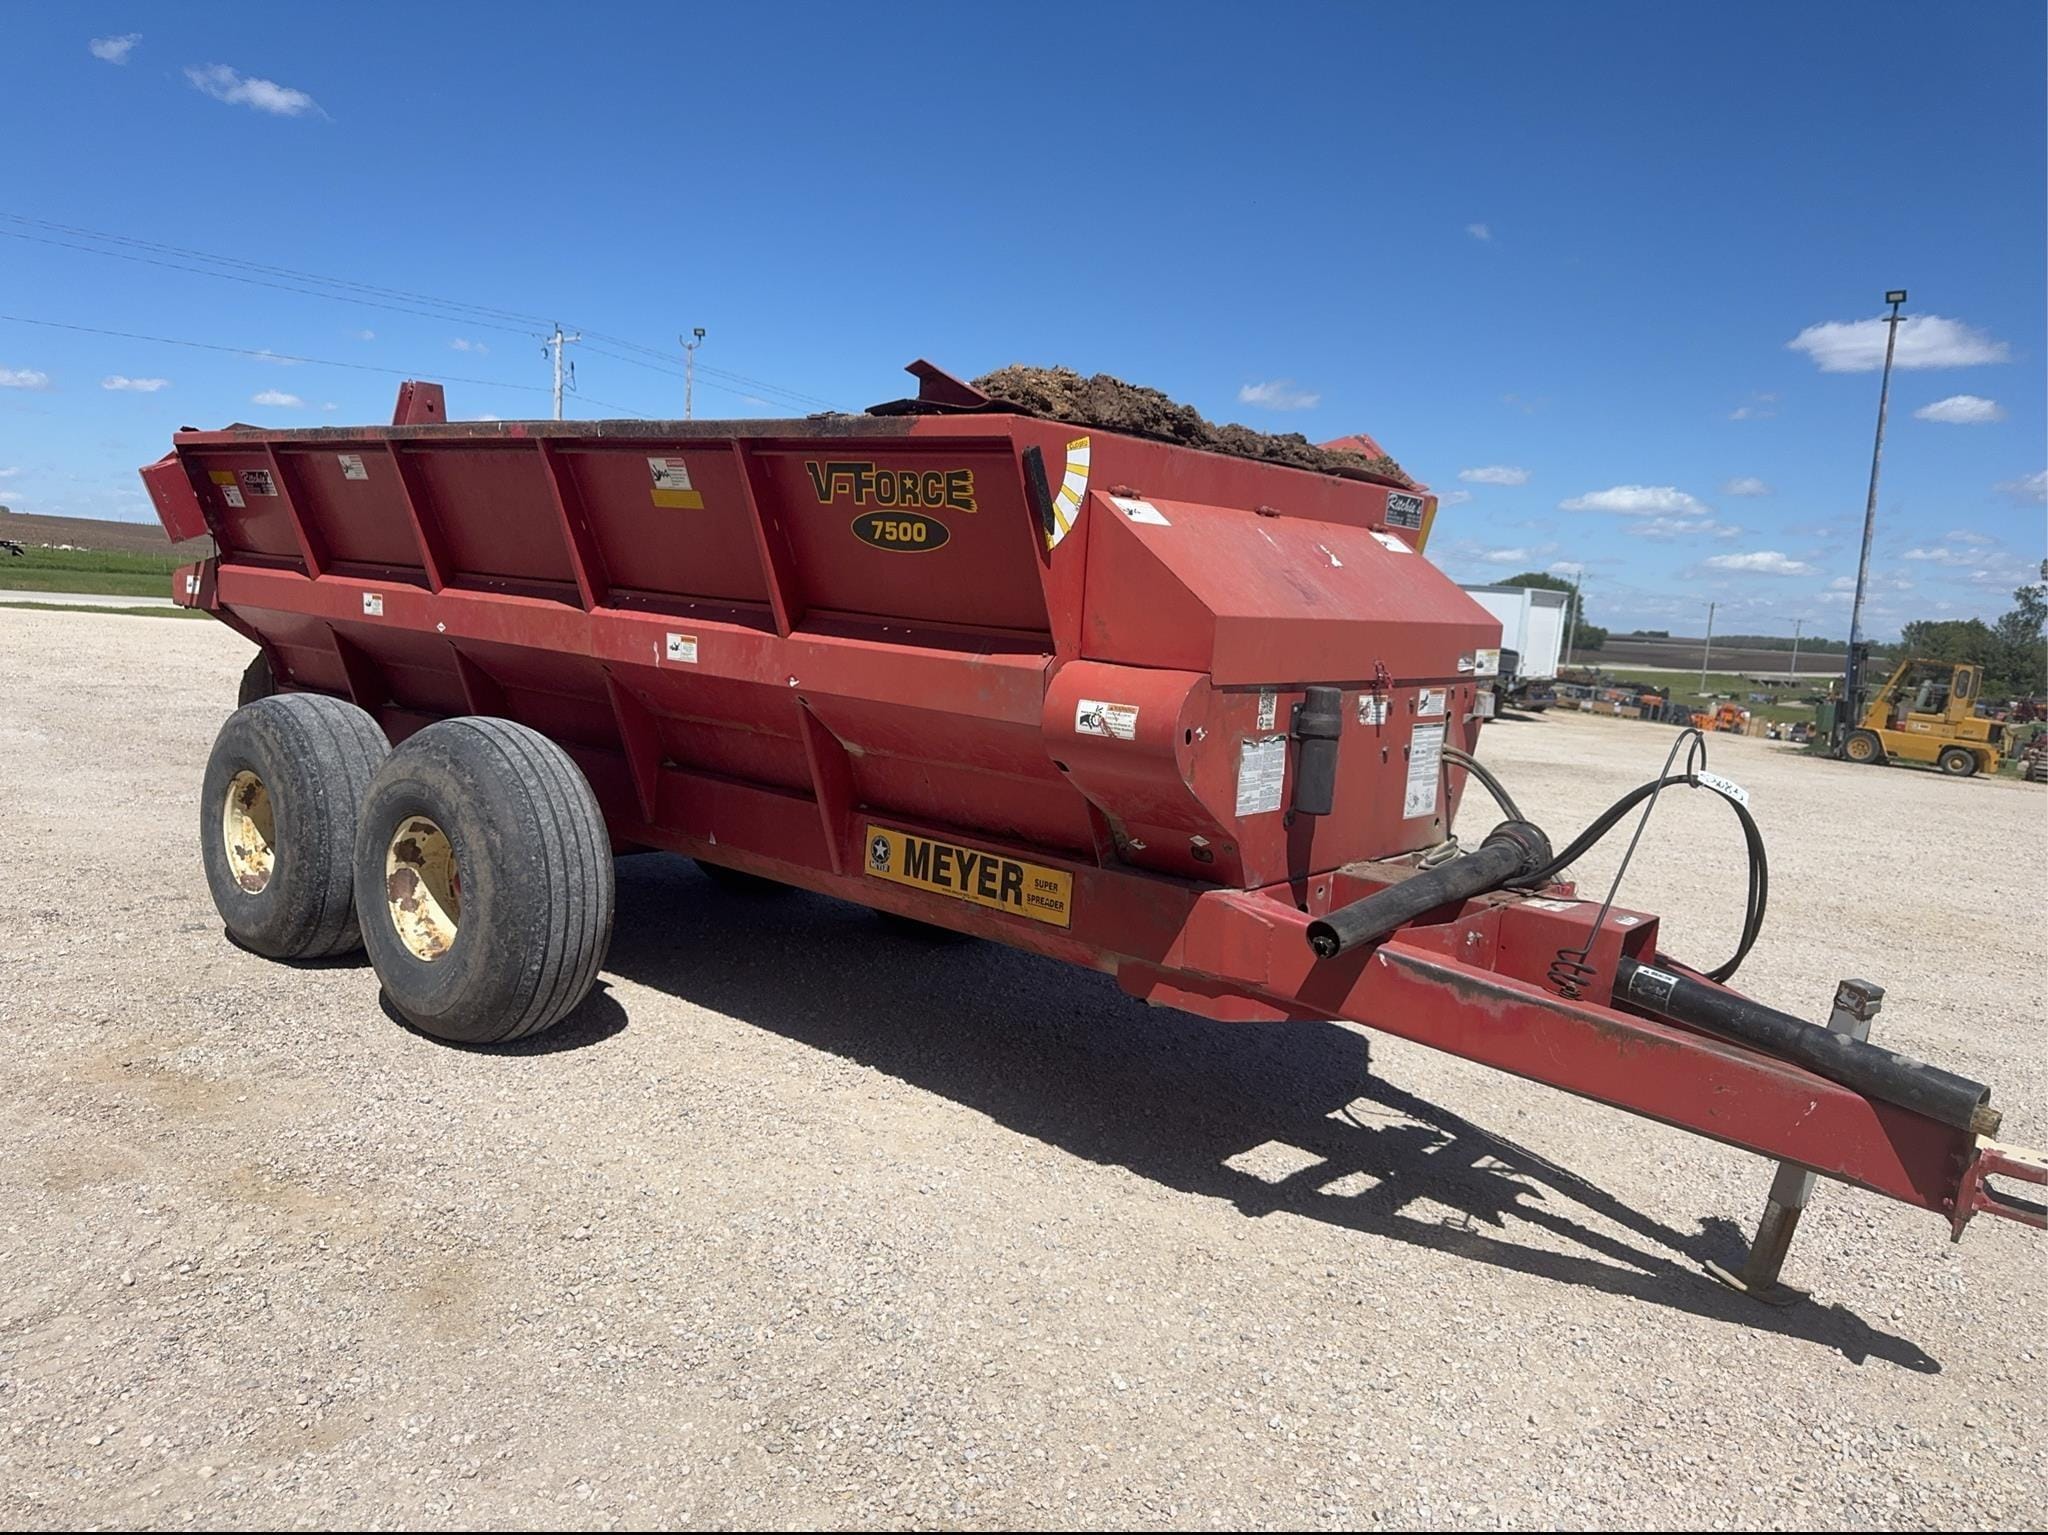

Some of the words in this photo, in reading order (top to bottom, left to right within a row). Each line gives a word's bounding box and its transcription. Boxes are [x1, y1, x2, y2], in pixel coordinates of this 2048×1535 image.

[871, 520, 927, 543] 7500
[904, 837, 1023, 906] MEYER
[1033, 878, 1059, 892] SUPER
[1026, 893, 1065, 912] SPREADER
